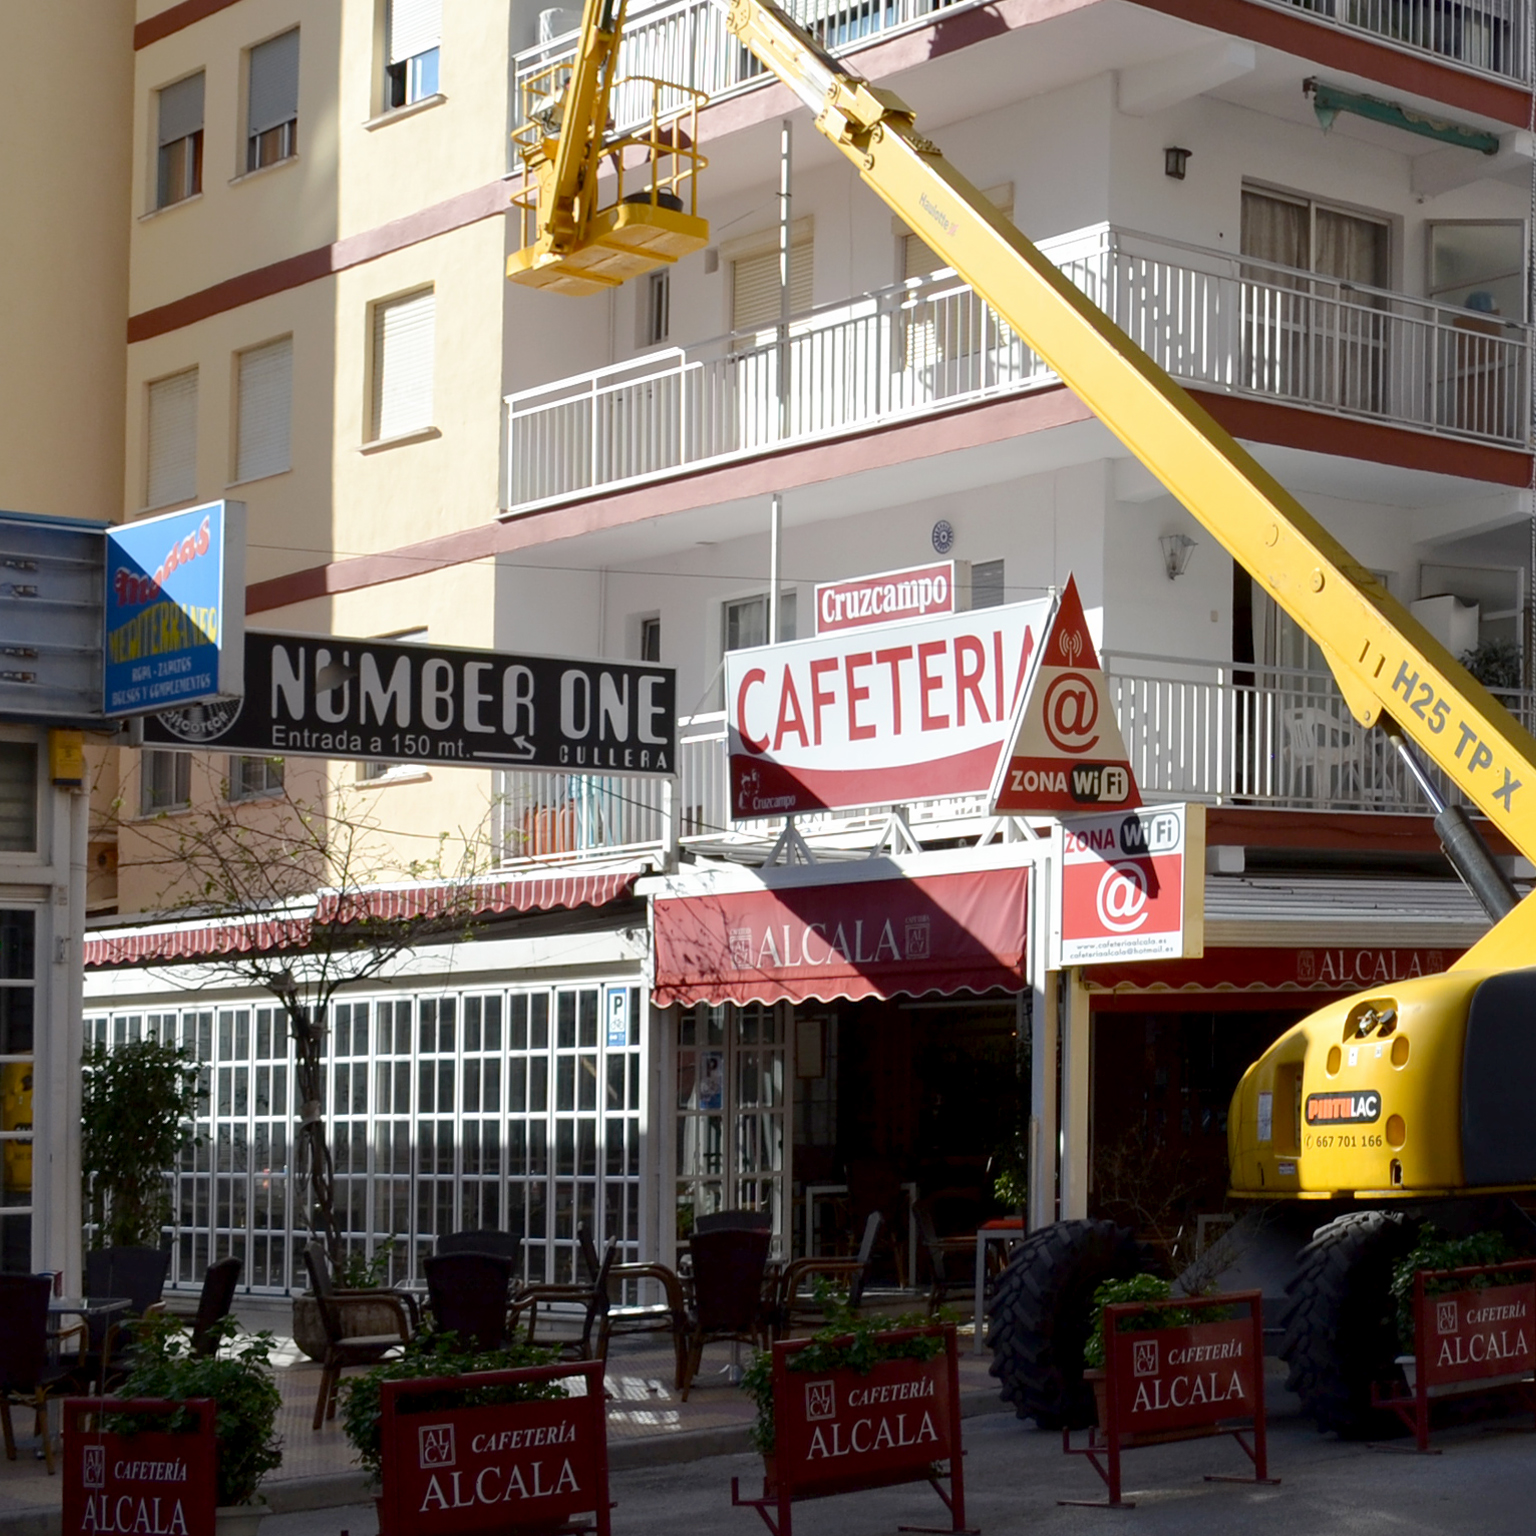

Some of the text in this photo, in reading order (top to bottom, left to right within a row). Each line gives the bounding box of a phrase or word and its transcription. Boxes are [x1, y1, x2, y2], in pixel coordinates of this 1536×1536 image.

[821, 574, 948, 624] Cruzcampo
[271, 645, 668, 744] NUMBER ONE
[272, 725, 471, 758] Entrada a 150 mt.
[1391, 660, 1523, 813] H25 TP X
[559, 744, 668, 769] CULLERA
[1011, 770, 1068, 793] ZONA
[752, 793, 796, 811] Cruzcampo
[1064, 828, 1116, 853] ZONA
[756, 917, 902, 968] ALCALA
[1069, 946, 1174, 959] cafeteriaalcala@hotmail.es
[1076, 937, 1167, 950] www.cafeteriaalcala.es
[1318, 950, 1423, 981] ALCALA
[614, 996, 623, 1015] P
[1316, 1134, 1382, 1148] 667 701 166
[1167, 1338, 1243, 1365] CAFETERÍA
[1436, 1328, 1529, 1367] ALCALA
[848, 1376, 934, 1407] CAFETERÍA
[1131, 1369, 1245, 1413] ALCALA
[471, 1419, 577, 1453] CAFETERÍA
[806, 1410, 938, 1460] ALCALA
[114, 1457, 188, 1482] CAFETERÍA
[418, 1457, 582, 1512] ALCALA
[81, 1495, 190, 1536] ALCALA
